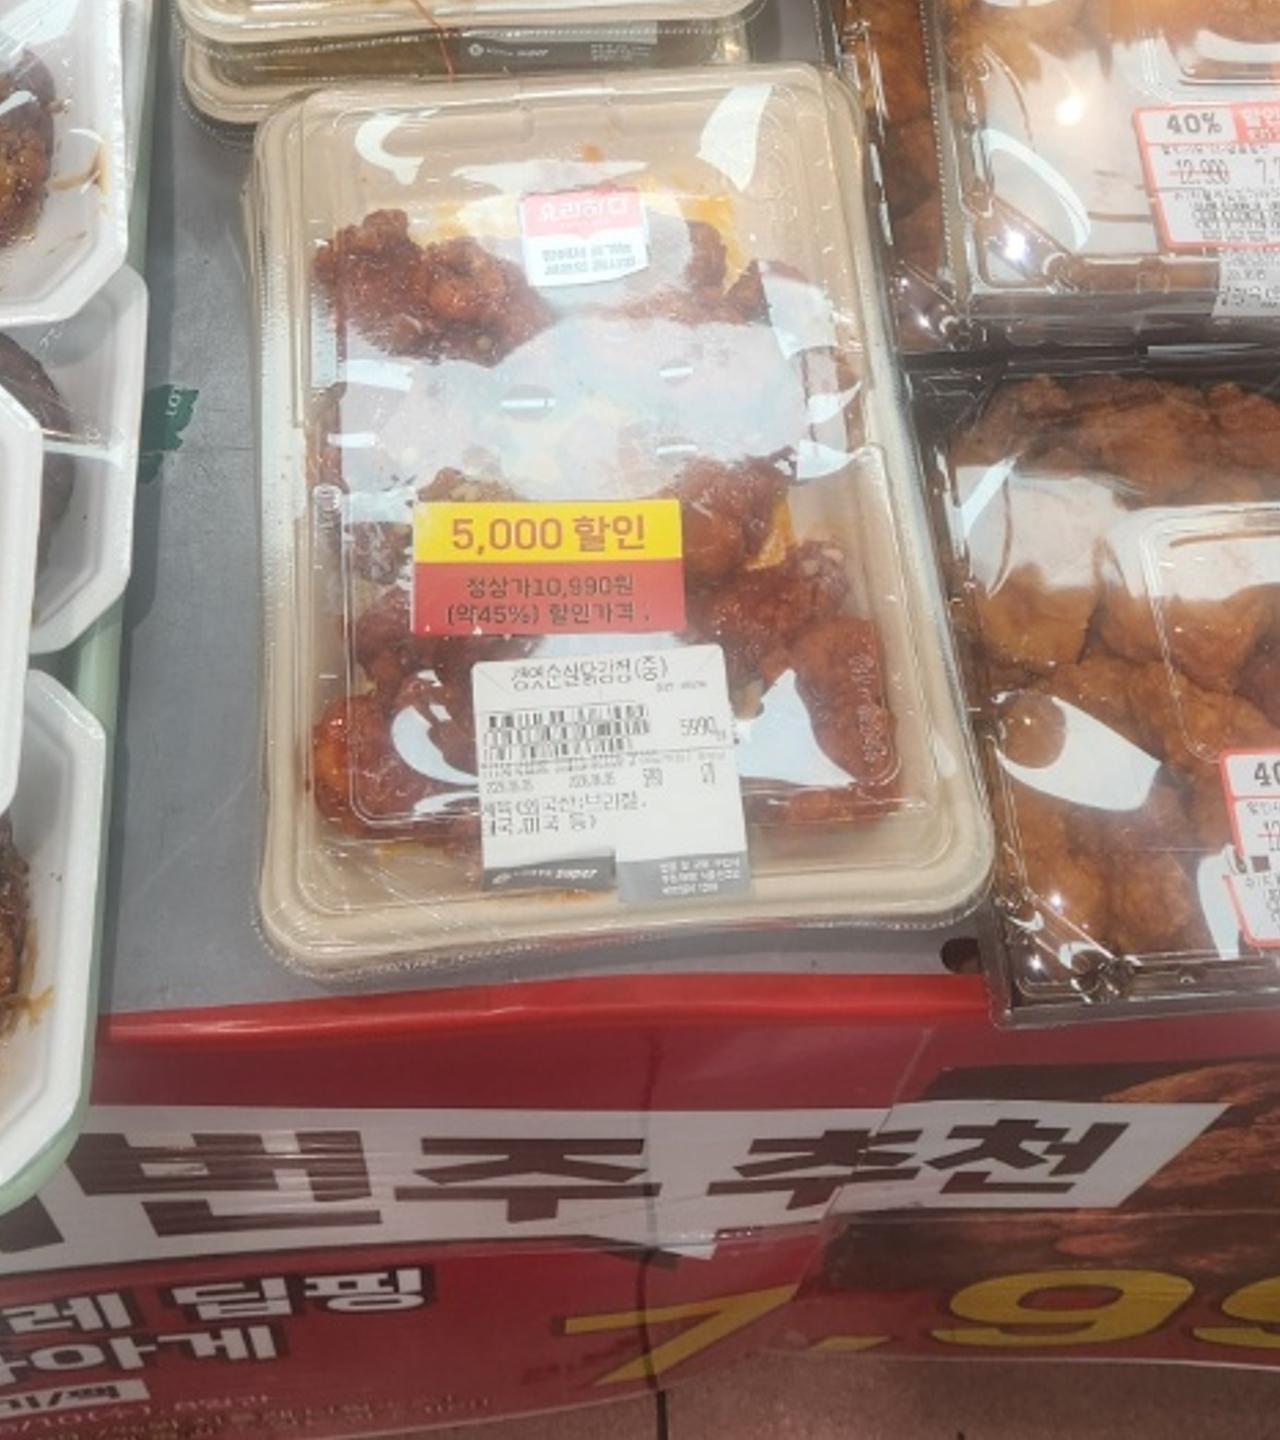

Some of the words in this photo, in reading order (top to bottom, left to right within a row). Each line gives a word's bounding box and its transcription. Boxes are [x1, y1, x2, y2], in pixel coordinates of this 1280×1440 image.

[1166, 112, 1222, 134] 40%
[452, 517, 563, 555] 5,000
[573, 515, 645, 552] 할인
[447, 604, 540, 625] (약45%)
[708, 1118, 1131, 1210] 추천
[170, 1268, 426, 1322] 딥핑
